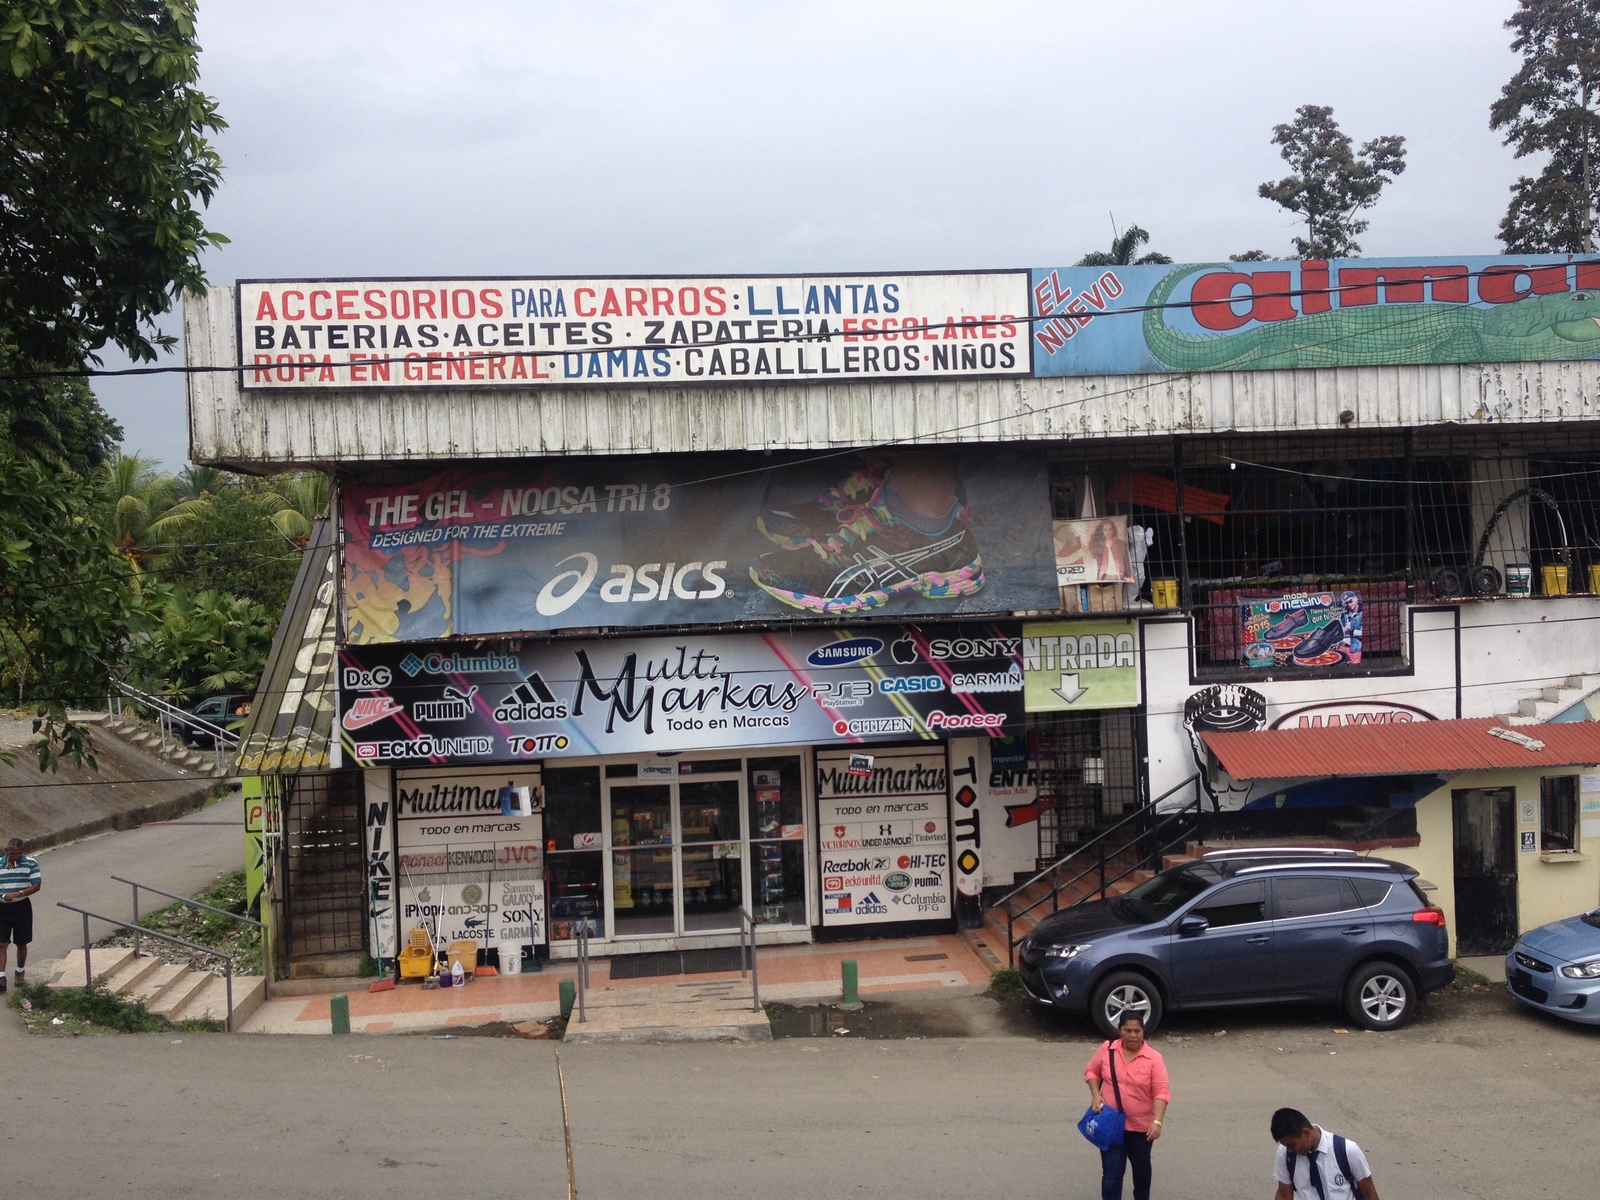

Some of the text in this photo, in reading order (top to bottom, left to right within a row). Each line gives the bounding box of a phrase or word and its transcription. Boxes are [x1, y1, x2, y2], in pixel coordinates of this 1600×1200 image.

[255, 287, 504, 321] ACCESORIOS
[511, 287, 567, 318] PARA
[747, 283, 900, 316] LLANTAS
[1034, 269, 1072, 319] EL
[1035, 270, 1124, 356] NUEVO
[254, 314, 1017, 350] BATERIAS ACEITES ZAPATERIA ESCOLARES
[254, 353, 336, 383] ROPA
[349, 353, 391, 382] EN
[403, 351, 550, 381] GENERAL
[563, 349, 671, 379] DAMAS
[932, 342, 1015, 372] NIÑOS
[366, 494, 419, 527] THE
[424, 489, 474, 521] GEL
[501, 484, 597, 517] NOOSA
[604, 482, 649, 513] TRI
[653, 483, 671, 511] 8
[371, 521, 567, 548] DESIGNED FOR THE EXTREME
[1247, 620, 1271, 634] 2015
[817, 645, 874, 659] SAMSUNG
[930, 639, 1020, 659] SONY
[423, 653, 519, 674] Columbia
[345, 667, 392, 688] D&G
[880, 676, 943, 693] CASIO
[952, 672, 1020, 686] GARMIN
[812, 680, 874, 698] PS3
[352, 697, 391, 716] NIKE
[414, 701, 465, 720] PUMA
[494, 701, 567, 722] adidas
[822, 698, 864, 708] PlayStation 3
[666, 714, 790, 731] Todo en Marcas
[848, 717, 914, 734] CITIZEN
[927, 710, 1006, 729] Pioneer
[992, 755, 1025, 763] movistar
[835, 802, 929, 816] TODO en marcas
[419, 825, 451, 836] TODO
[454, 825, 469, 834] en
[915, 832, 946, 842] Timberland
[366, 801, 392, 901] NIKE
[821, 839, 861, 850] VICTORINOX
[399, 844, 538, 869] Pioneer KENWOOD JVC
[823, 853, 946, 874] Reebok HI-TEC
[503, 882, 535, 894] Samsung
[914, 876, 939, 888] PUMA
[502, 892, 535, 906] GALAXY
[902, 892, 946, 905] Columbia
[405, 904, 445, 918] iPhone
[502, 909, 543, 923] SONY
[855, 904, 888, 915] adidas
[918, 904, 939, 912] PFG
[451, 928, 495, 940] LACOSTE
[500, 926, 540, 940] GARMIN
